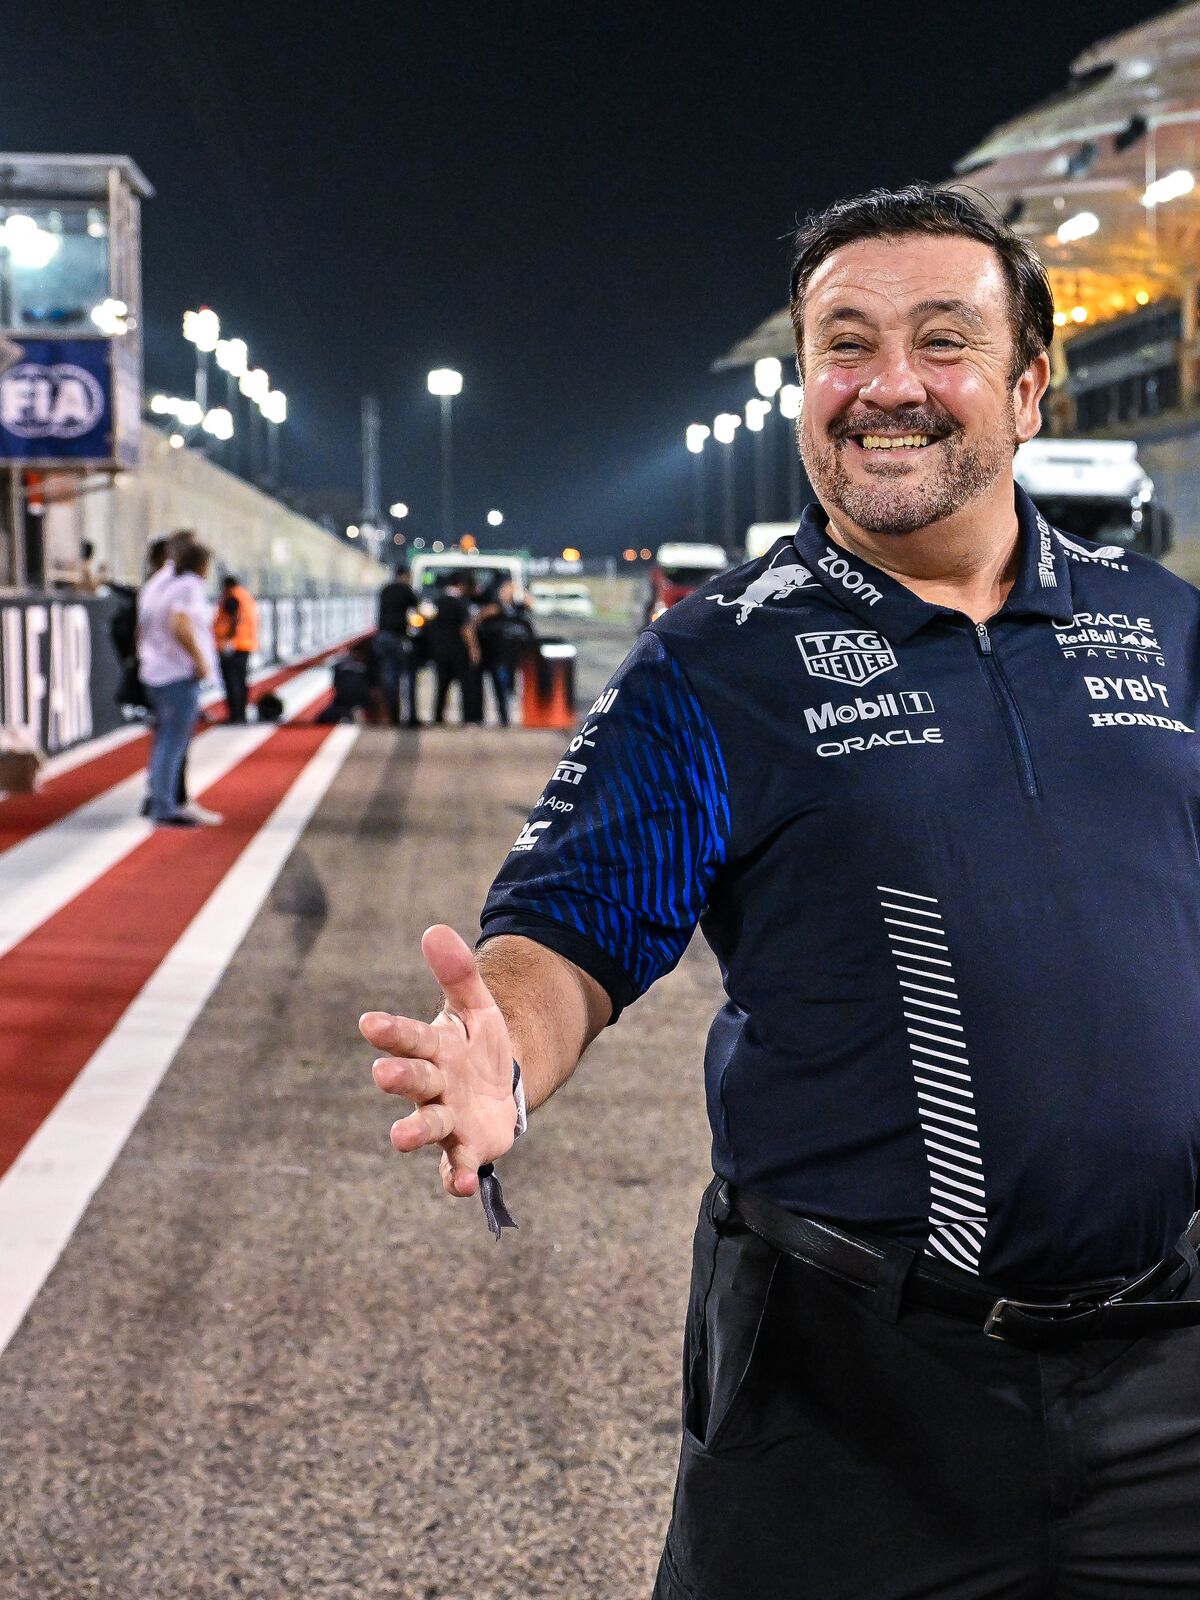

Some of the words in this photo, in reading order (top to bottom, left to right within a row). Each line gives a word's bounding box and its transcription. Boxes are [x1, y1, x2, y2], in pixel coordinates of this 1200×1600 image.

[1, 379, 89, 423] FIA
[804, 633, 883, 653] TAG
[1088, 628, 1118, 644] Bull
[811, 653, 892, 681] HEUER
[1063, 648, 1166, 667] RACING
[1084, 675, 1170, 708] BYBIT
[803, 693, 900, 734] Mobil
[908, 693, 925, 712] 1
[1089, 713, 1195, 733] HONDA
[816, 728, 944, 758] ORACLE
[544, 796, 574, 812] App
